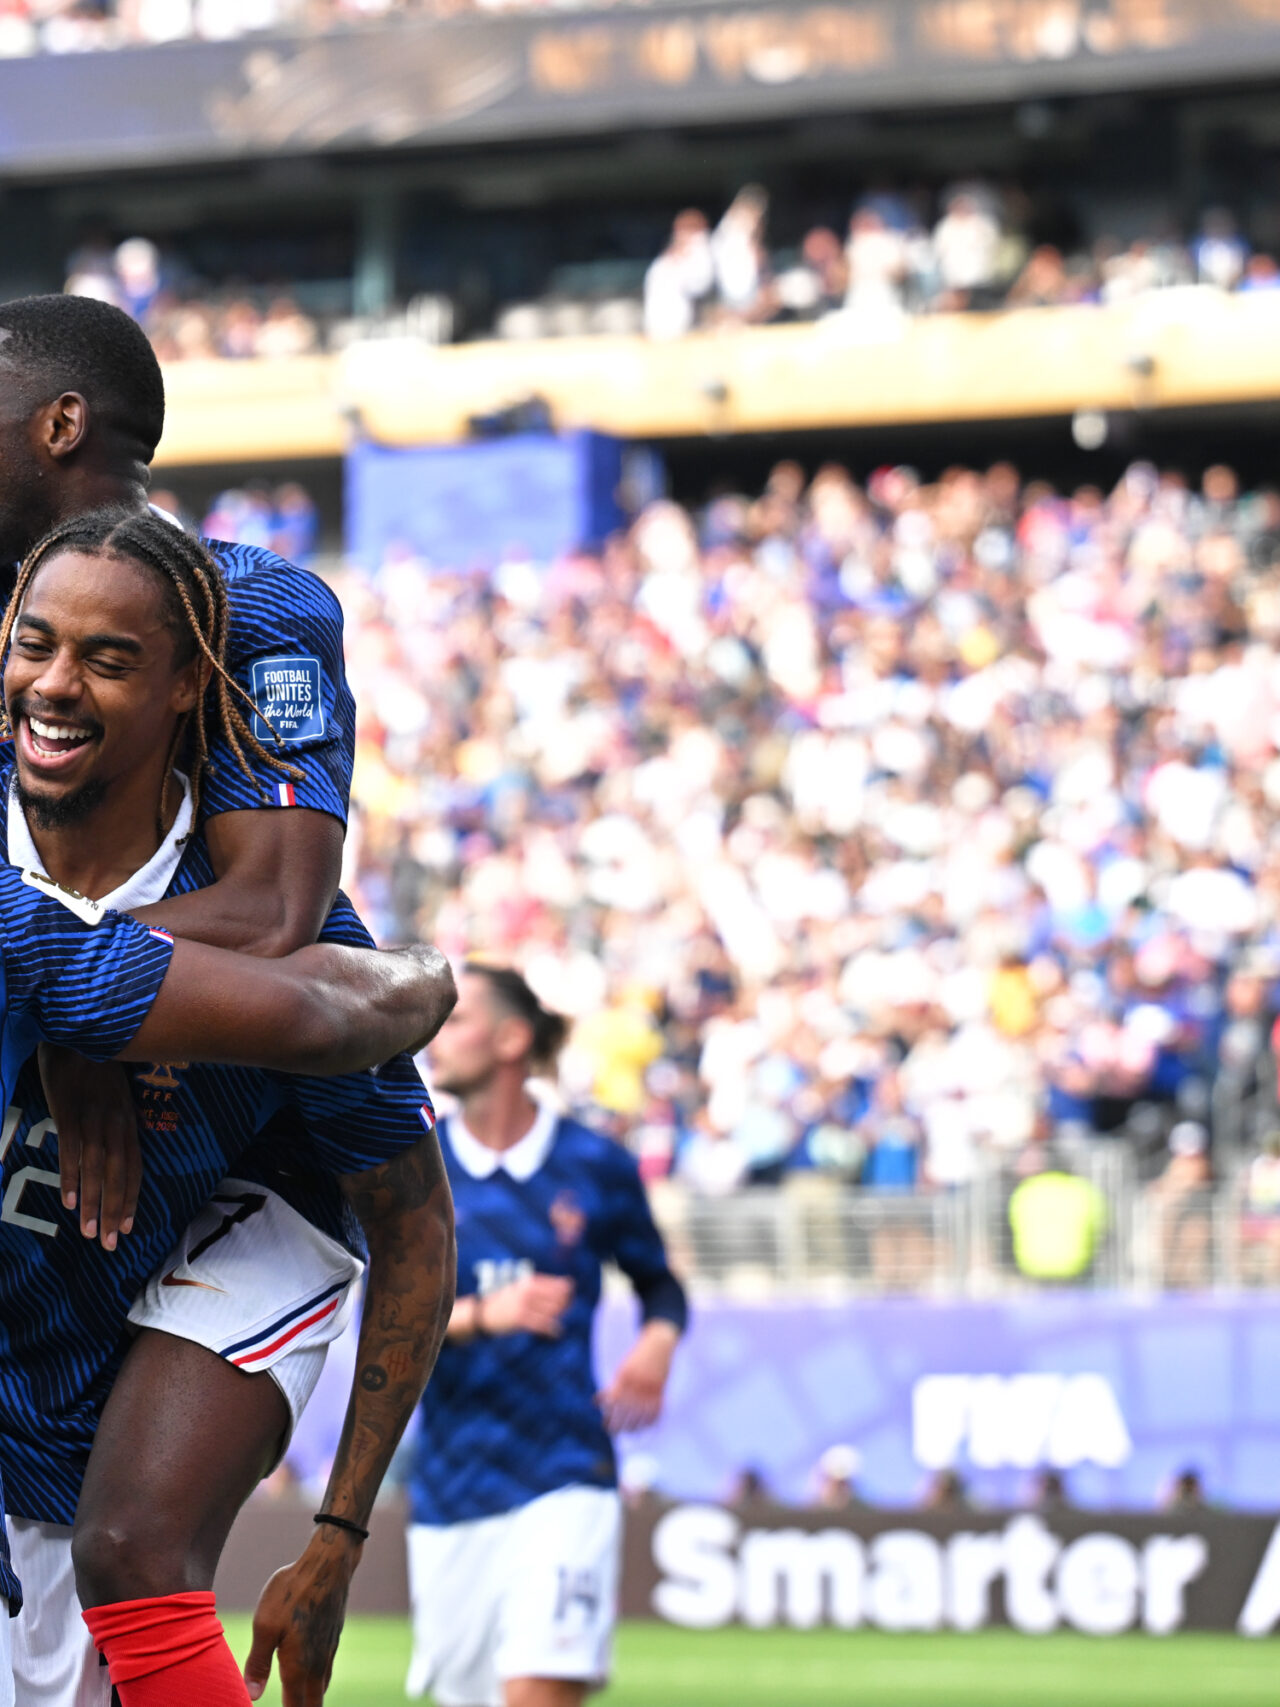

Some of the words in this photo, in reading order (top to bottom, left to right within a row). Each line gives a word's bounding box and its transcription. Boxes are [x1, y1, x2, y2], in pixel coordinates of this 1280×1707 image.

[264, 670, 311, 684] FOOTBALL
[265, 683, 312, 702] UNITES
[263, 703, 283, 718] the
[284, 703, 314, 719] World
[280, 720, 298, 729] FIFA
[912, 1371, 1132, 1469] FIFA
[652, 1505, 1207, 1634] Smarter
